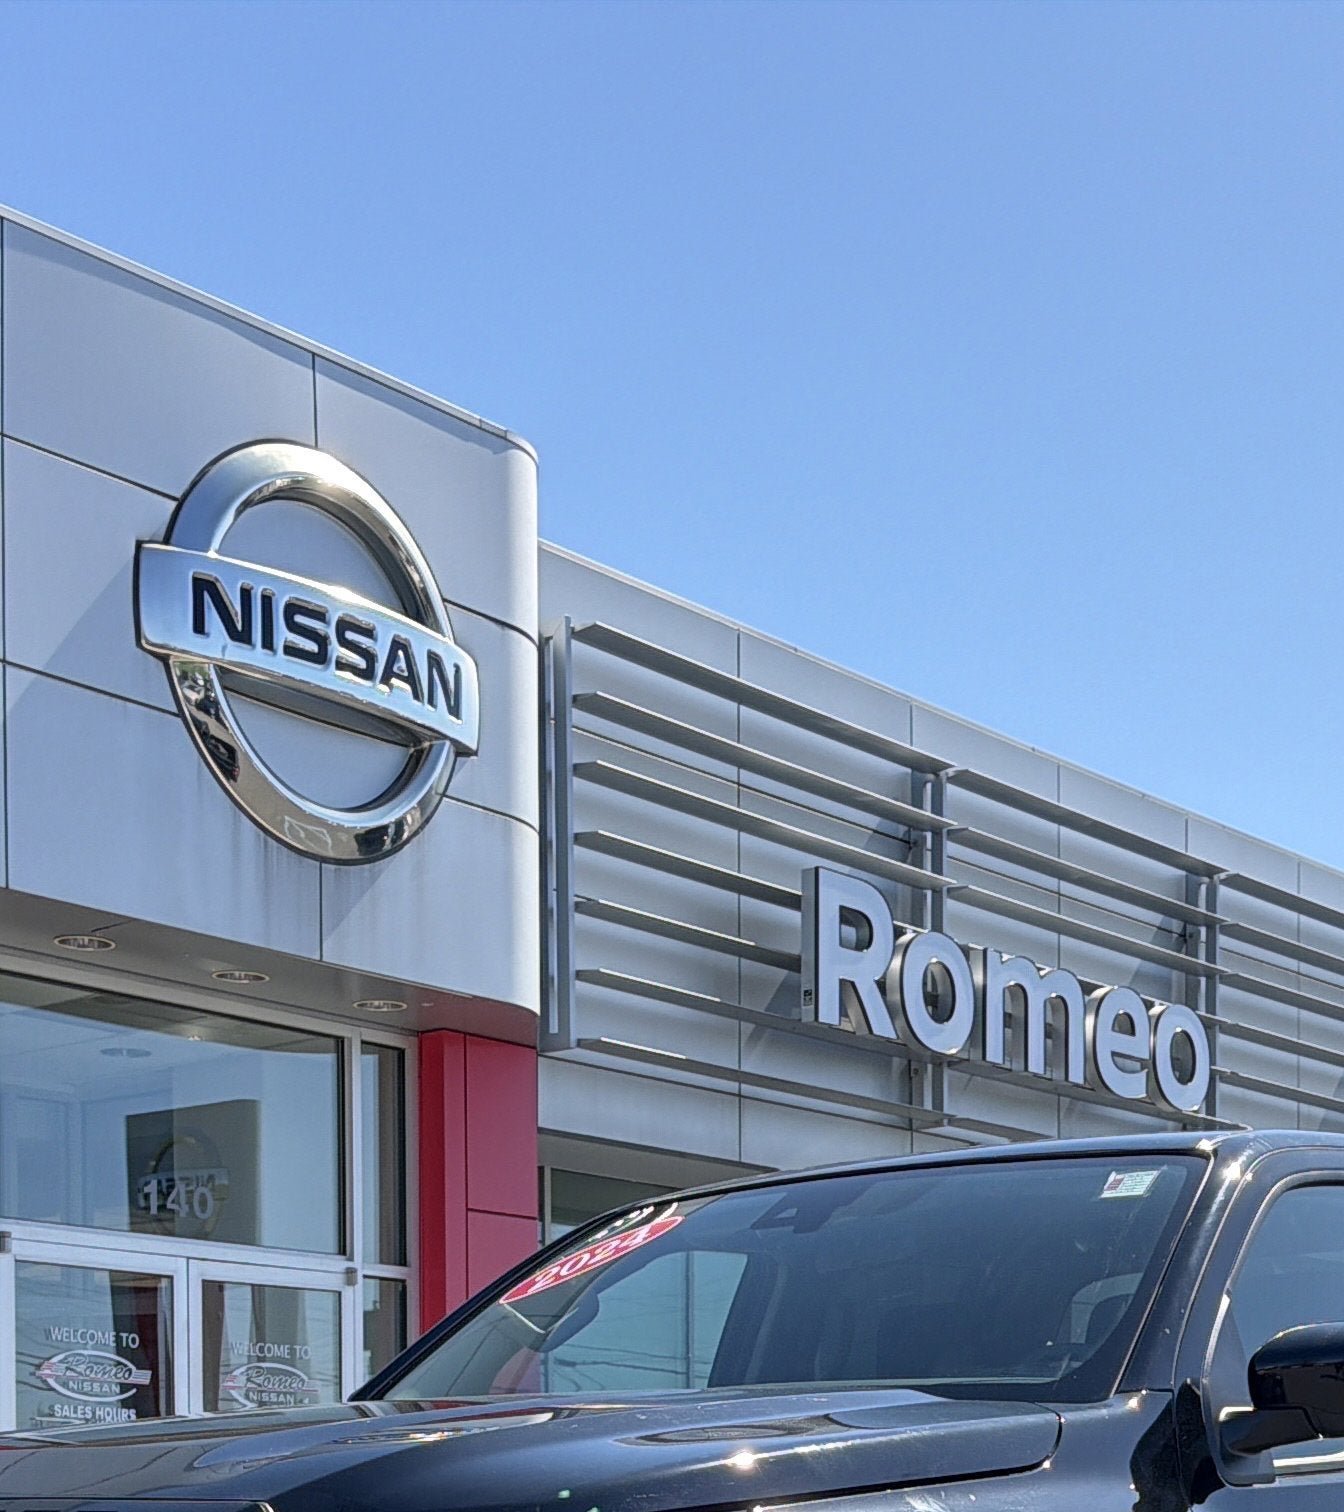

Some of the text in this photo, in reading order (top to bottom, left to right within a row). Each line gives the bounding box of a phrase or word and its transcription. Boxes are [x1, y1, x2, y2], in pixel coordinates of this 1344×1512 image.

[191, 571, 462, 725] NISSAN
[802, 865, 1210, 1112] Romeo
[143, 1179, 214, 1220] 140
[526, 1226, 653, 1293] 2024
[49, 1325, 140, 1349] WELCOME TO
[231, 1341, 312, 1360] WELCOME TO
[63, 1353, 134, 1382] Romeo
[244, 1366, 308, 1390] Romeo
[68, 1381, 121, 1394] NISSAN
[248, 1391, 295, 1403] NISSAN
[53, 1403, 137, 1422] SALES HOURS
